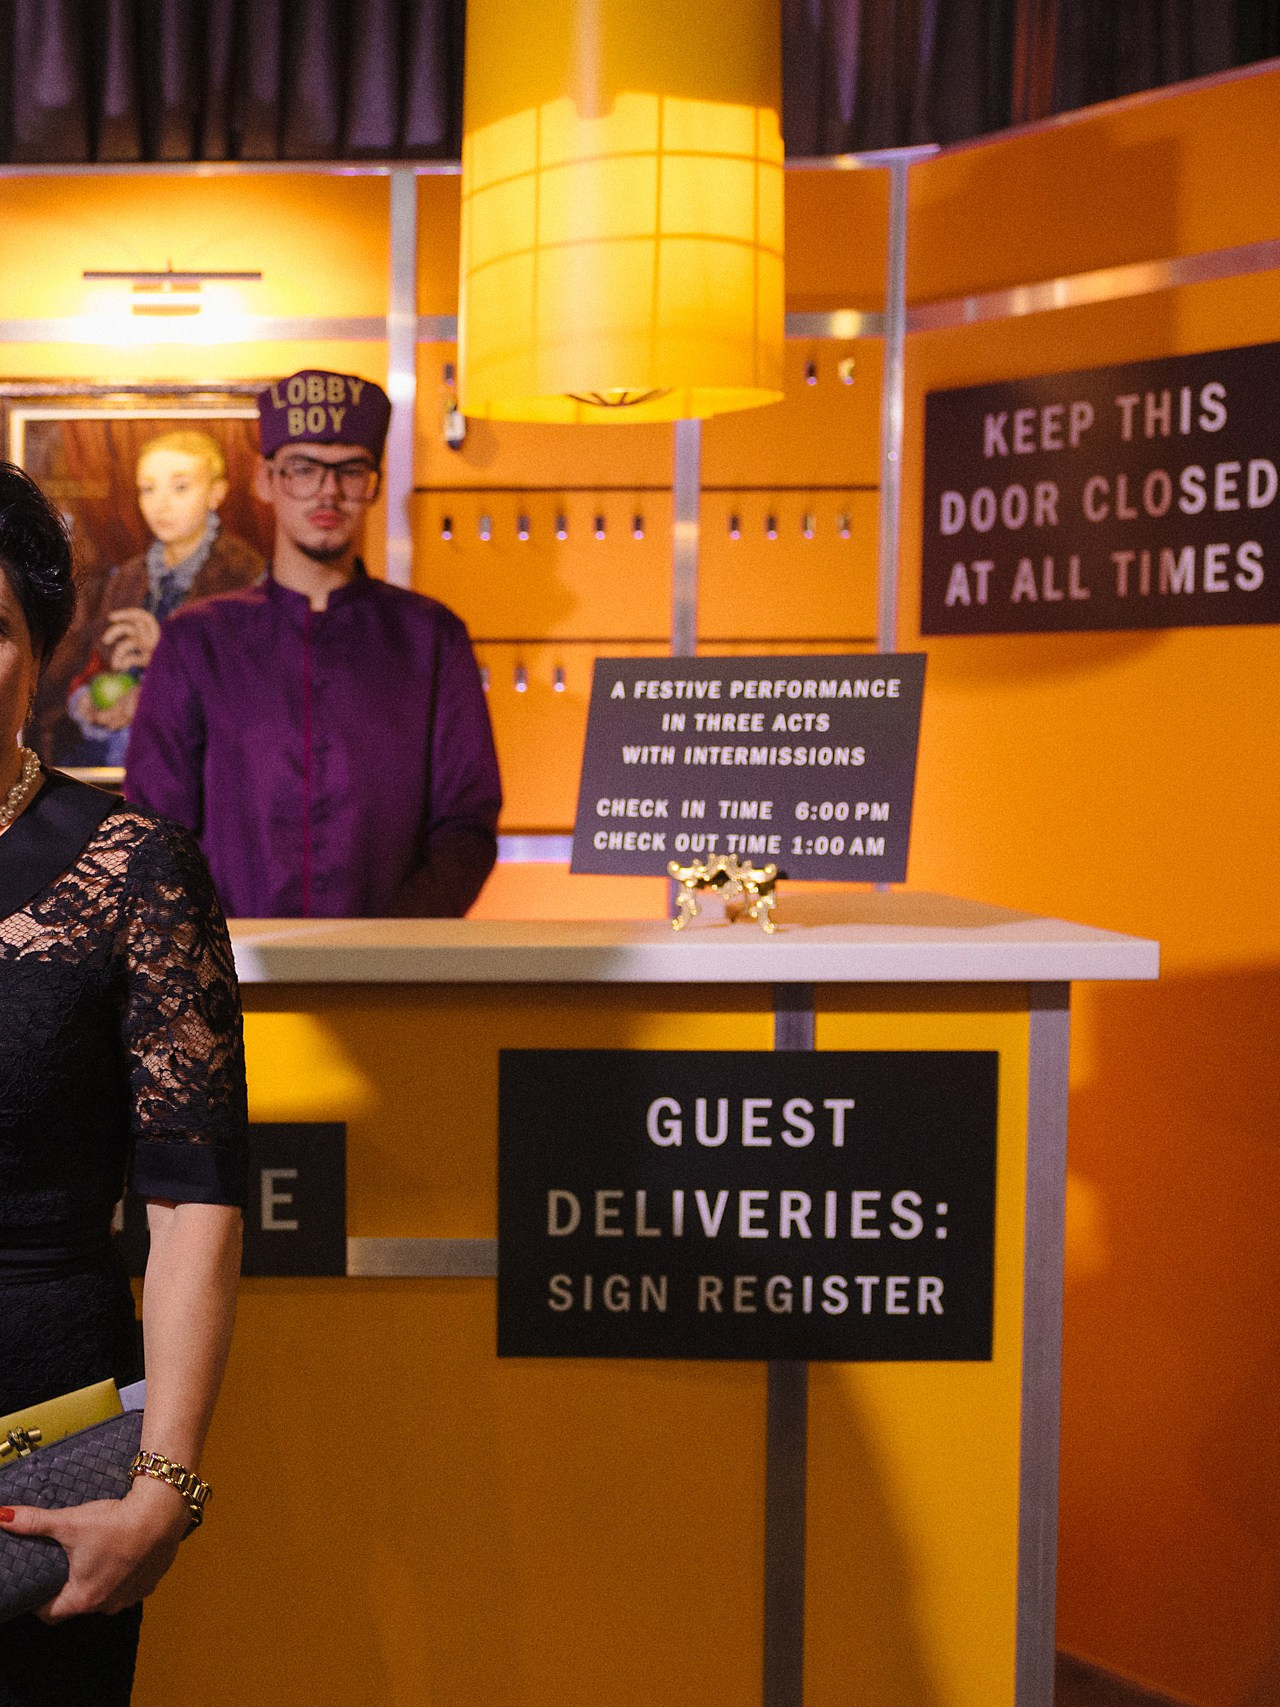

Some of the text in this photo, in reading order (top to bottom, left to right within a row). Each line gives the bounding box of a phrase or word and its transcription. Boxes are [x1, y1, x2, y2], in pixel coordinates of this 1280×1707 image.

[271, 375, 365, 410] LOBBY
[287, 405, 347, 437] BOY
[983, 381, 1228, 458] KEEP THIS
[939, 458, 1278, 535] DOOR CLOSED
[944, 541, 1264, 606] AT ALL TIMES
[610, 678, 902, 700] A FESTIVE PERFORMANCE
[661, 713, 831, 732] IN THREE ACTS
[622, 745, 867, 766] WITH INTERMISSIONS
[596, 798, 891, 822] CHECK IN TIME 6:00 PM
[593, 831, 886, 856] CHECK OUT TIME 1:00 AM
[646, 1096, 856, 1148] GUEST
[547, 1189, 949, 1240] DELIVERIES:
[548, 1273, 945, 1316] SIGN REGISTER
